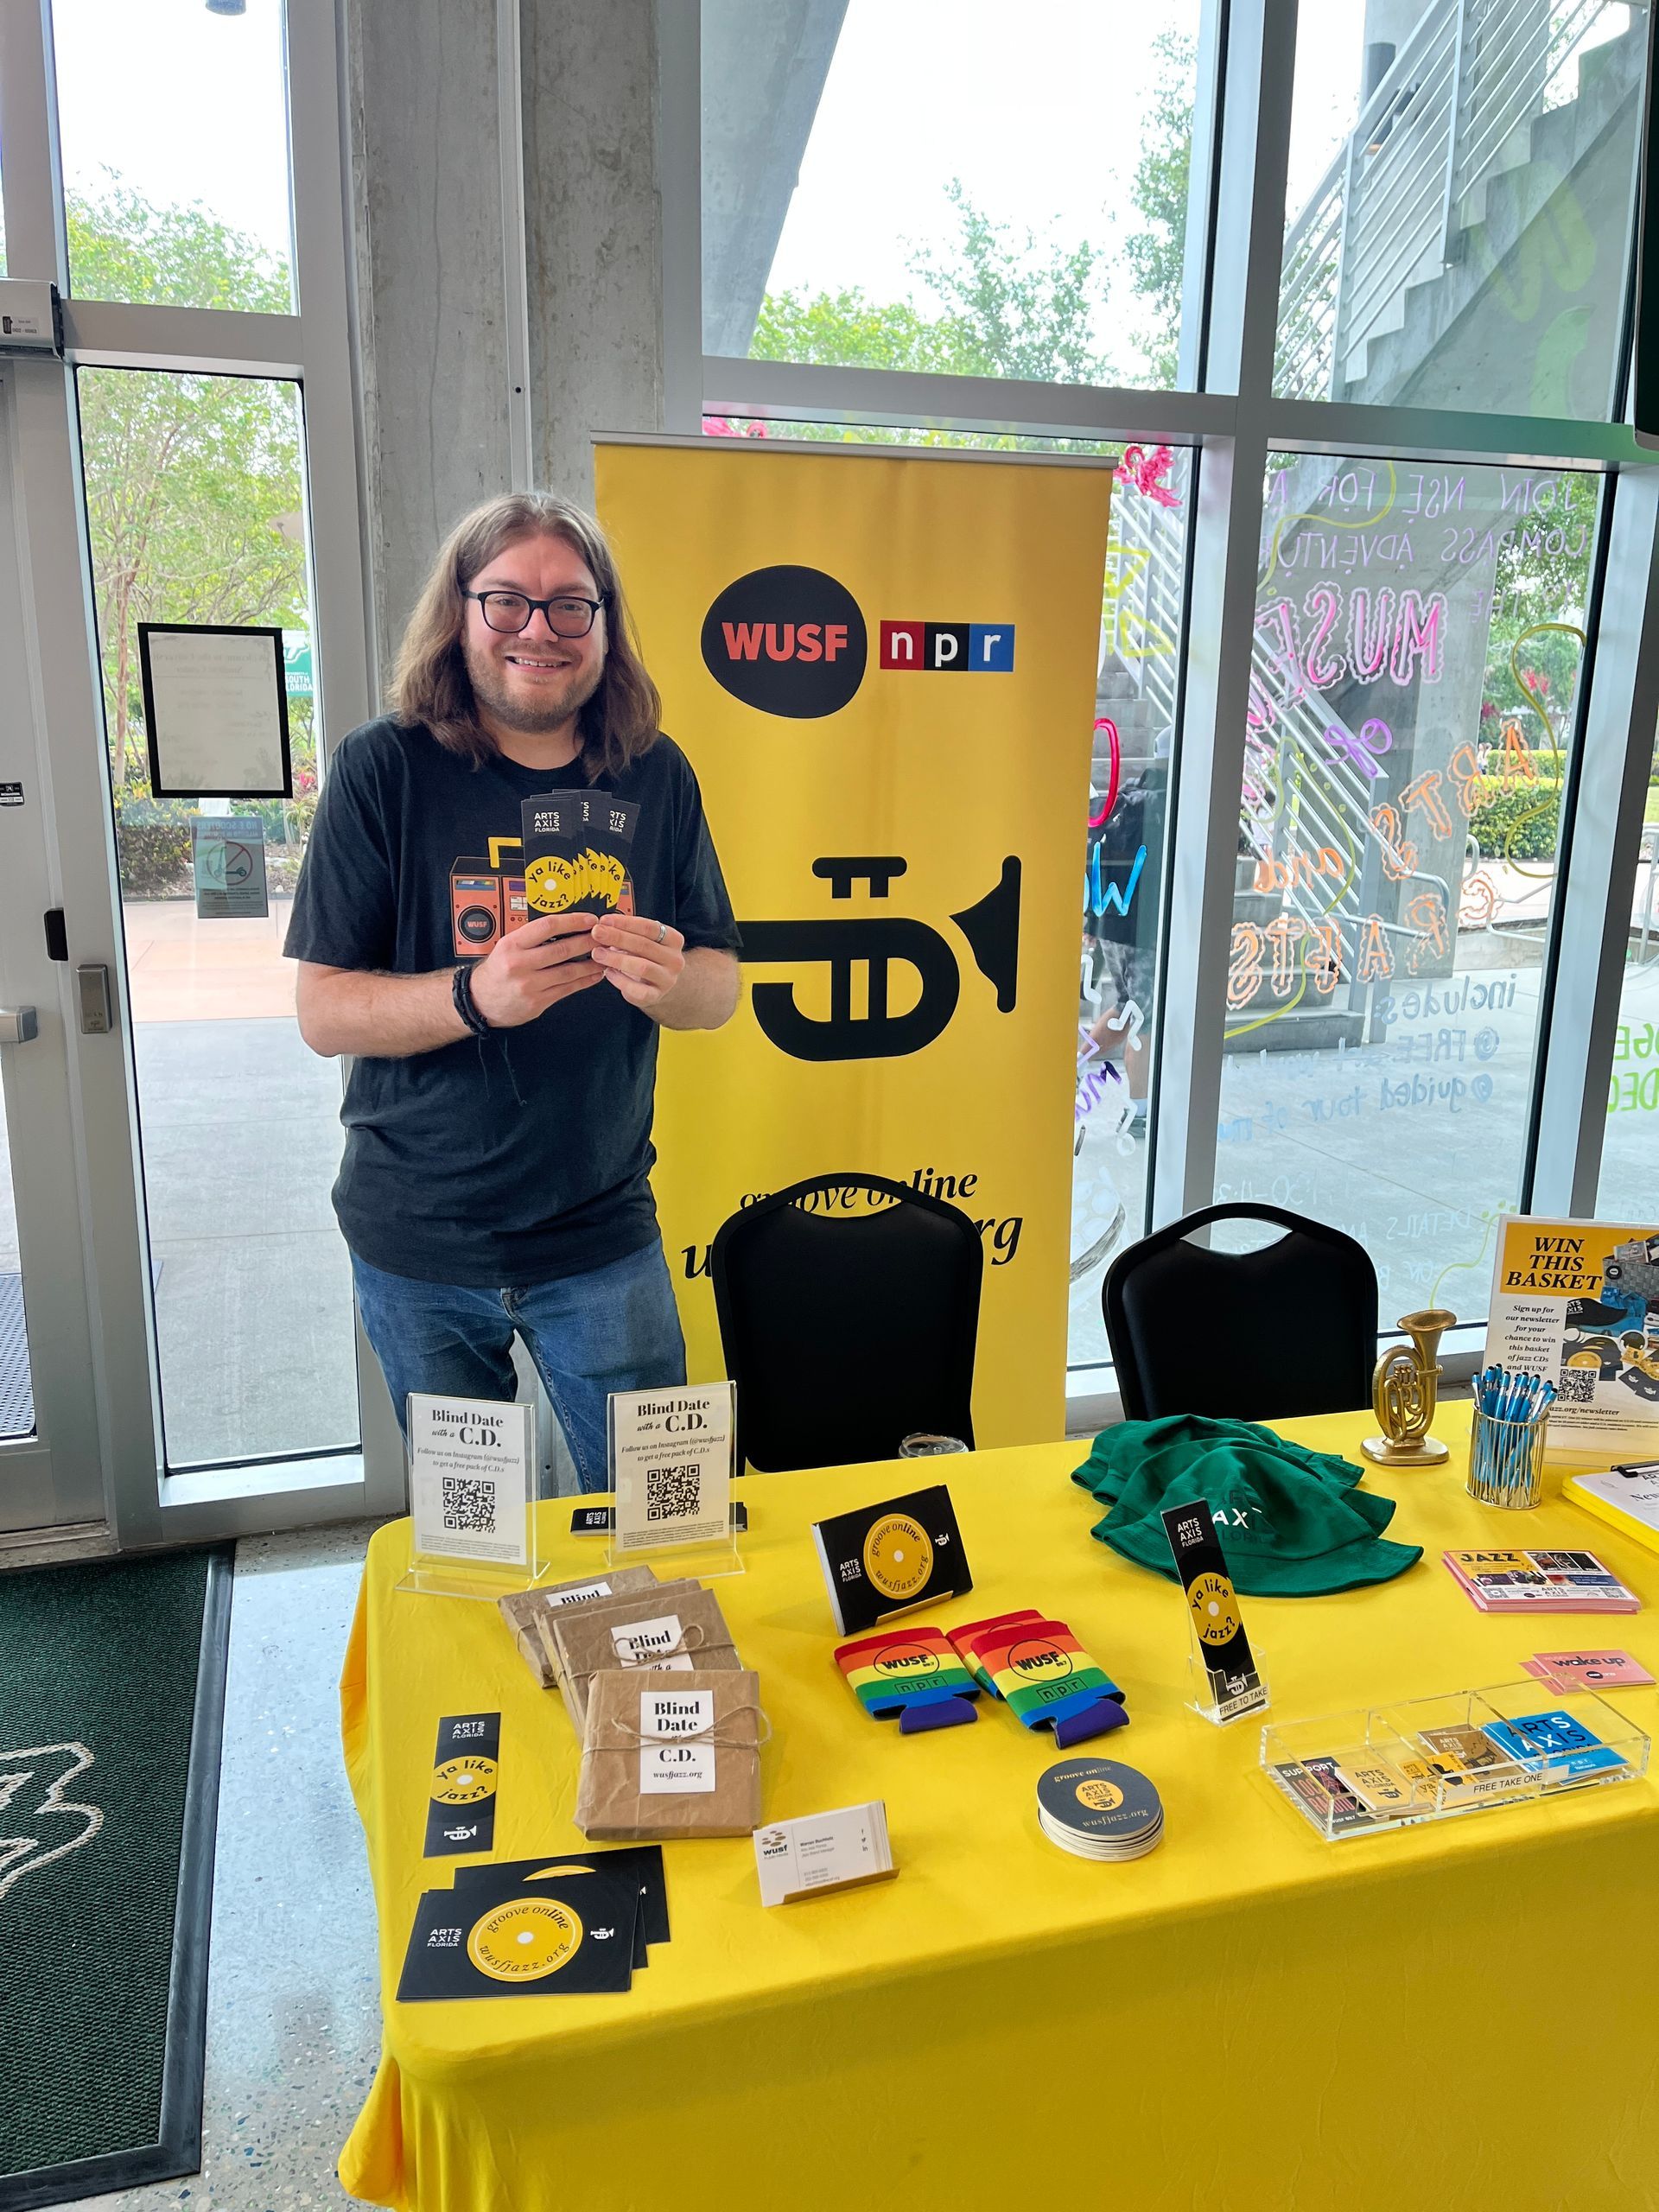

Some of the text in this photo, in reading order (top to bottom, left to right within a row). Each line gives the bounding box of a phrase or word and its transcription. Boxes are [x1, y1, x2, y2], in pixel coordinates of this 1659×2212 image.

[721, 622, 849, 662] WUSF
[891, 631, 1002, 668] npr
[534, 811, 560, 820] ARTS
[534, 819, 560, 828] AXIS
[529, 861, 571, 883] ya like
[532, 893, 569, 909] jazz?
[467, 920, 487, 929] WUSF
[1535, 1236, 1585, 1254] WIN
[1529, 1255, 1584, 1272] THIS
[1505, 1271, 1603, 1290] BASKET
[1513, 1305, 1530, 1313] Sign
[1520, 1315, 1560, 1324] newsletter
[638, 1400, 710, 1417] Blind Date
[432, 1409, 504, 1428] Blind Date
[637, 1421, 653, 1432] with
[664, 1413, 708, 1433] C.D.
[431, 1428, 448, 1438] with
[459, 1427, 502, 1447] C.D.
[658, 1440, 689, 1449] Instagram
[417, 1446, 435, 1456] Follow
[452, 1451, 483, 1460] Instagram
[658, 1452, 671, 1460] free
[671, 1450, 686, 1459] pack
[686, 1448, 693, 1457] of
[465, 1463, 480, 1471] pack
[480, 1464, 488, 1472] of
[1177, 1517, 1199, 1533] ARTS
[872, 1522, 921, 1558] groove online
[1179, 1527, 1202, 1542] AXIS
[1181, 1535, 1204, 1548] FLORIDA
[840, 1558, 860, 1571] ARTS
[1460, 1553, 1521, 1563] JAZZ
[841, 1565, 861, 1579] AXIS
[842, 1573, 862, 1583] FLORIDA
[875, 1555, 929, 1592] wusfjazz.org
[1192, 1578, 1230, 1611] ya like
[1203, 1616, 1236, 1640] jazz?
[628, 1630, 671, 1649] Blind
[881, 1654, 929, 1669] WUSF
[1015, 1651, 1060, 1671] WUSF
[1553, 1656, 1602, 1667] wake
[1602, 1657, 1626, 1667] up
[901, 1678, 940, 1693] npr
[1043, 1681, 1080, 1700] npr
[654, 1701, 700, 1715] Blind
[1219, 1687, 1268, 1716] FREE TO TAKE
[657, 1719, 698, 1732] Date
[1507, 1716, 1571, 1738] ARTS
[1521, 1729, 1586, 1752] AXIS
[658, 1749, 696, 1763] C.D.
[435, 1759, 493, 1780] ya like
[653, 1770, 702, 1780] wusfjazz.org
[1053, 1765, 1112, 1783] groove online
[1282, 1762, 1335, 1777] SUPPORT
[1354, 1769, 1384, 1778] ARTS
[1361, 1776, 1390, 1784] AXIS
[1473, 1773, 1542, 1794] FREE TAKE ONE
[437, 1785, 488, 1801] jazz?
[1082, 1783, 1108, 1793] ARTS
[1085, 1788, 1110, 1798] AXIS
[1082, 1808, 1148, 1827] wusfjazz.org
[763, 1844, 788, 1856] wusf
[486, 1906, 569, 1934] groove online
[430, 1928, 462, 1936] ARTS
[479, 1942, 569, 1974] wusfjazz.org
